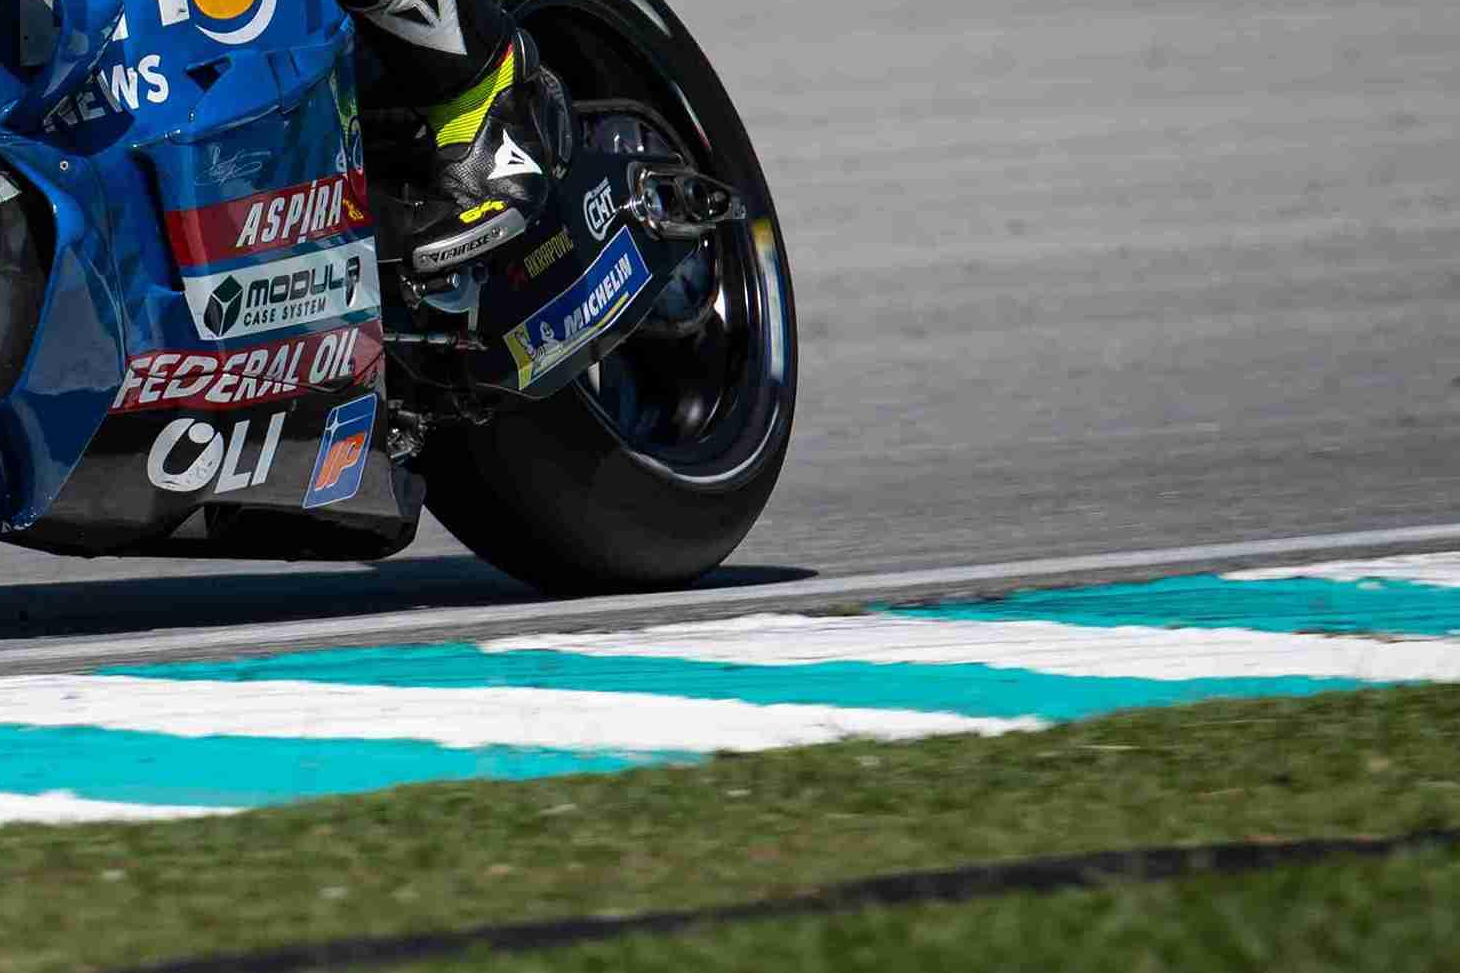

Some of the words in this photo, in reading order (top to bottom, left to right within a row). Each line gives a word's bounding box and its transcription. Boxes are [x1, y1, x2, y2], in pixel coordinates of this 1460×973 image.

[243, 308, 276, 327] CASE
[281, 299, 327, 320] SYSTEM
[563, 253, 633, 340] MICHELIN
[112, 341, 306, 410] FEDERAL
[308, 327, 359, 385] OIL
